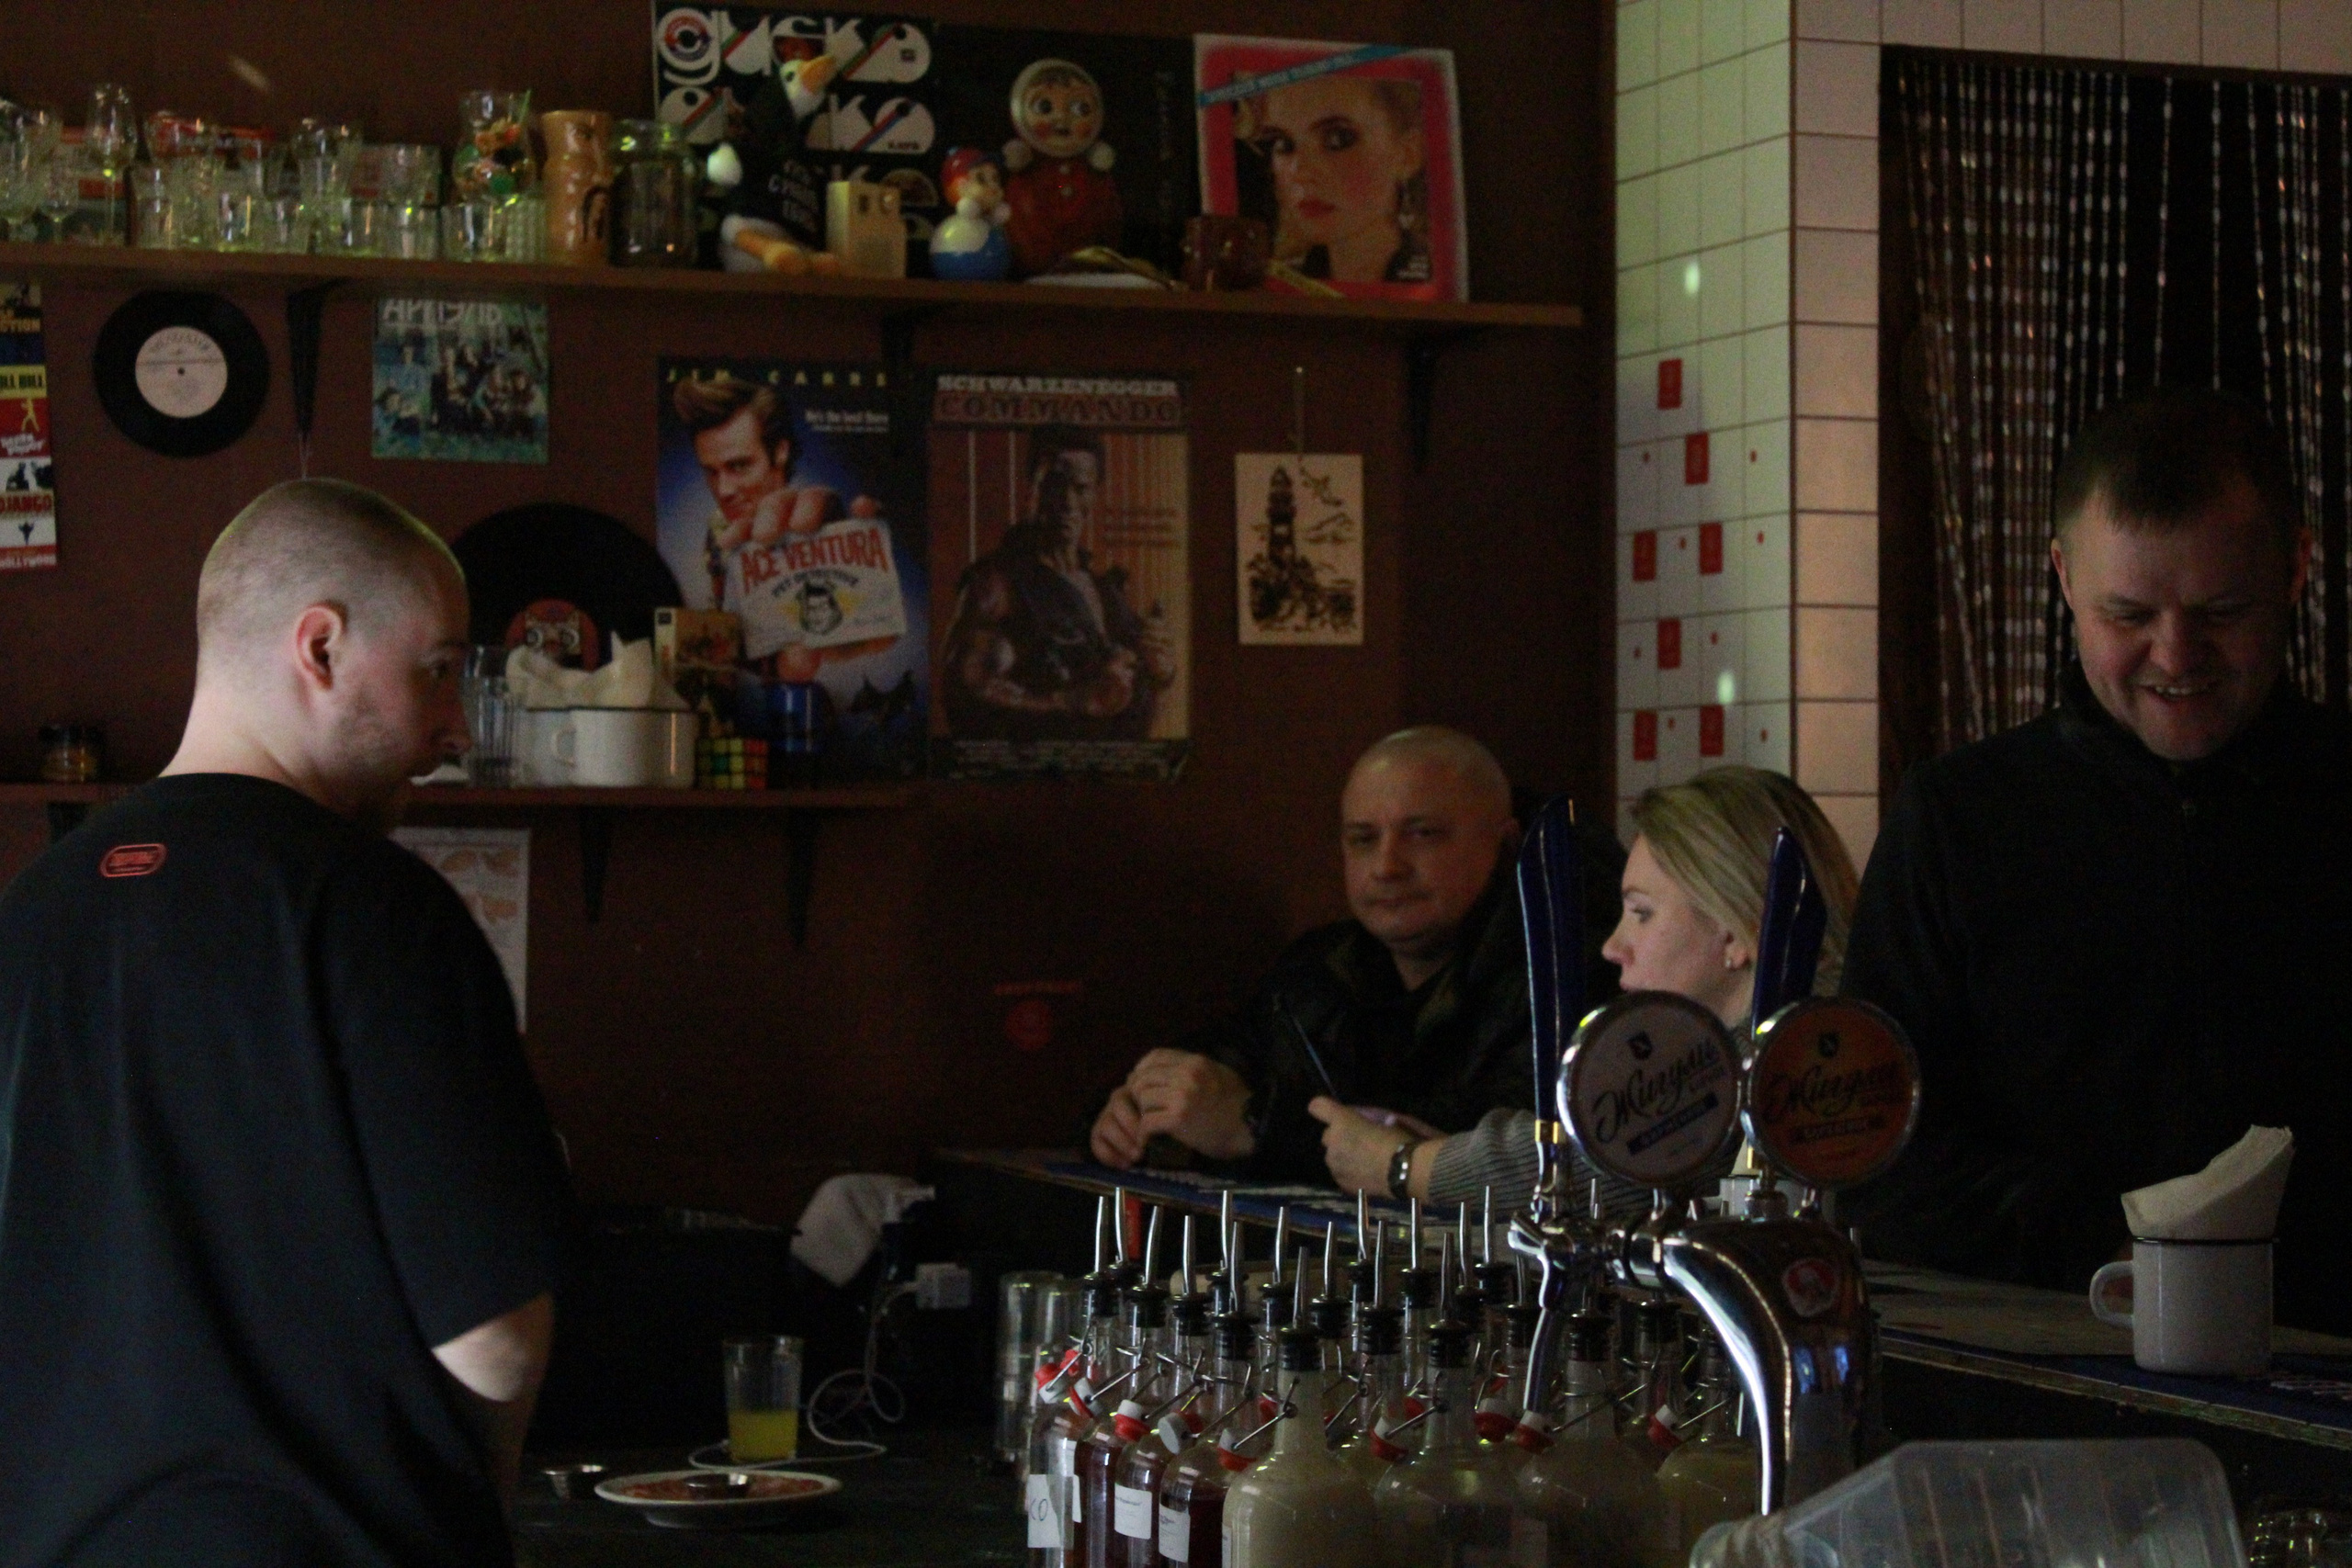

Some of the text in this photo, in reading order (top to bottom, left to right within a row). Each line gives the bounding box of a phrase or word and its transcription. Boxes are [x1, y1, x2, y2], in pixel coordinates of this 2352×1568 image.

[938, 395, 1181, 423] COMMANDO
[741, 527, 889, 593] ACE VENTURA
